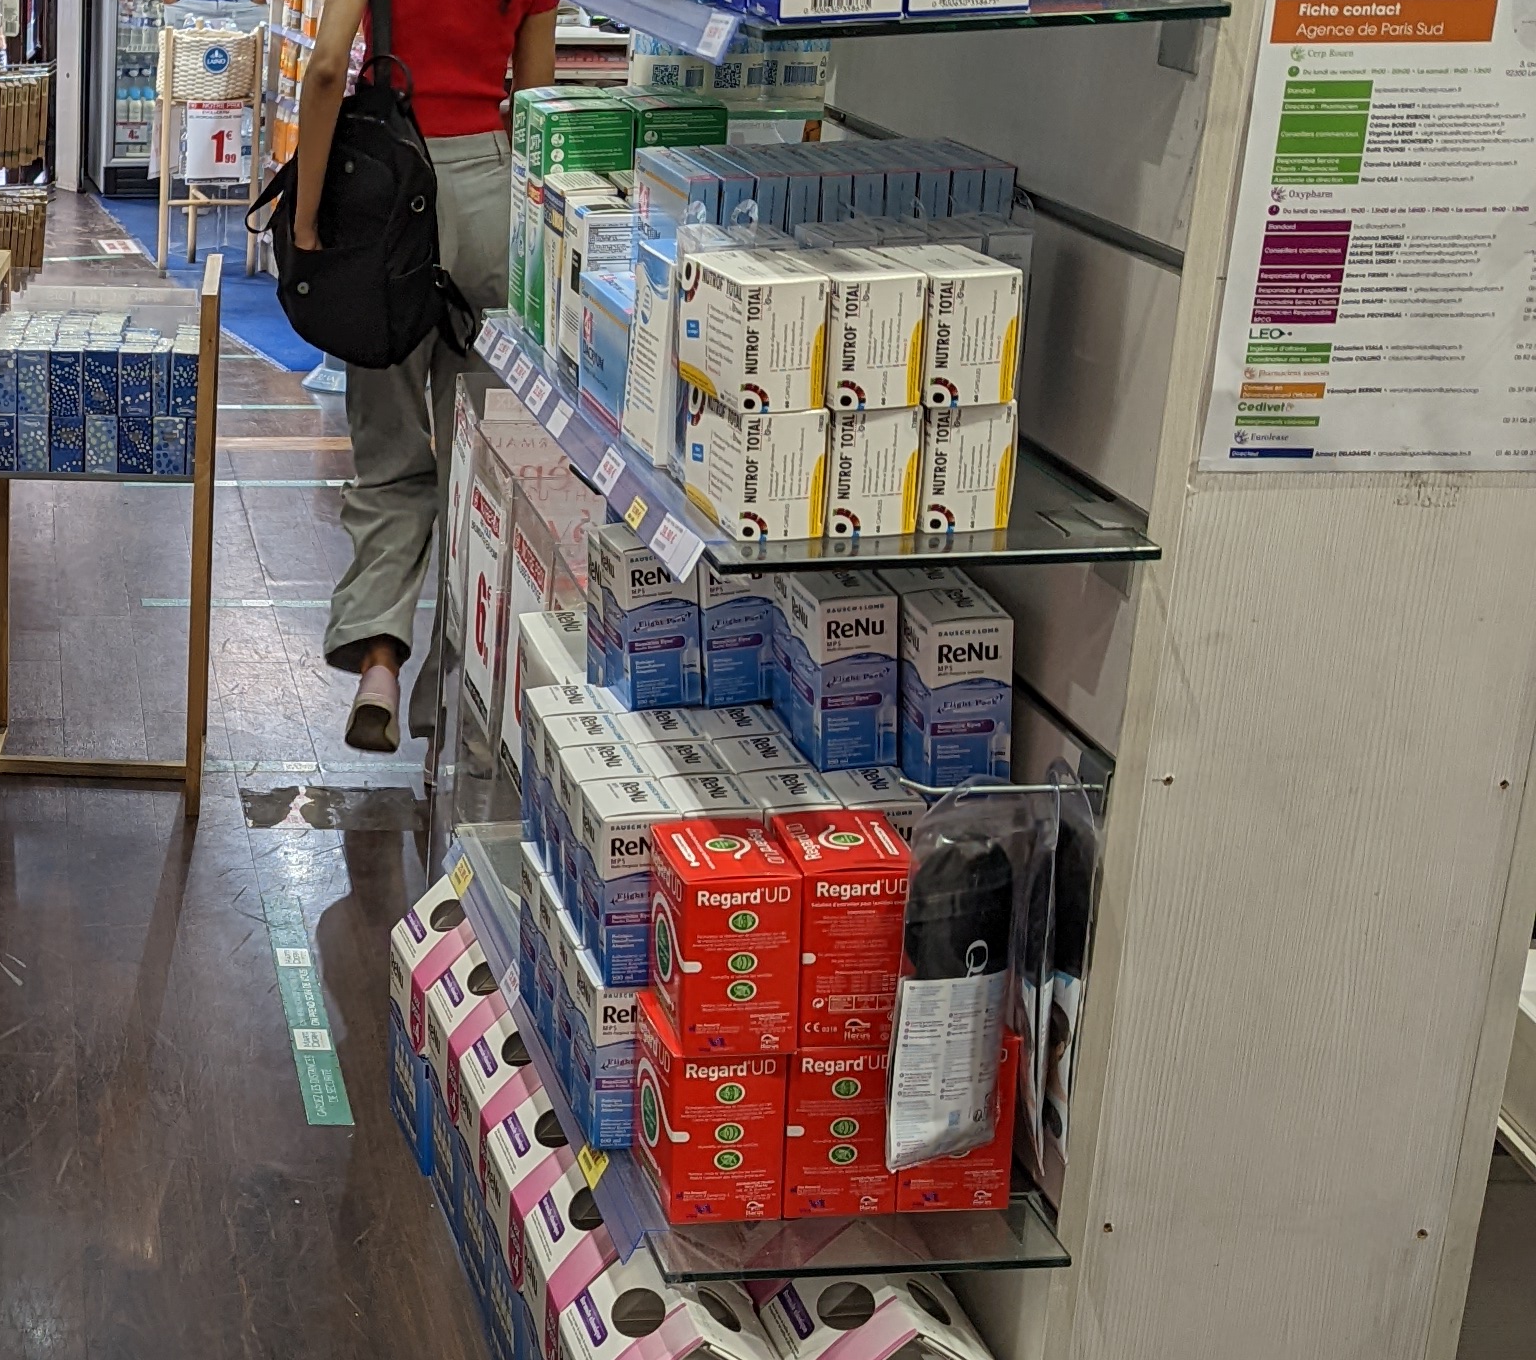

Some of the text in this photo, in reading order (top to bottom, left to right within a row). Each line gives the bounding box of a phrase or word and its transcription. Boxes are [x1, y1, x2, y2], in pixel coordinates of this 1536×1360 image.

[1298, 2, 1402, 17] Fiche contact
[1296, 21, 1445, 39] Agence de Paris Sud
[745, 286, 762, 376] NUTROF TOTAL
[841, 282, 860, 372] NUTROF TOTAL
[936, 280, 954, 370] NUTROF TOTAL
[744, 417, 762, 504] NUTROF TOTAL
[838, 413, 856, 500] NUTROF TOTAL
[933, 409, 952, 496] NUTROF TOTAL
[826, 618, 886, 640] ReNu
[938, 642, 1000, 663] ReNu
[578, 716, 605, 737] ReNu
[653, 710, 679, 732] ReNu
[726, 707, 753, 728] ReNu
[697, 886, 792, 910] Regard UD
[817, 878, 908, 901] Regard UD
[685, 1060, 777, 1082] Regard UD
